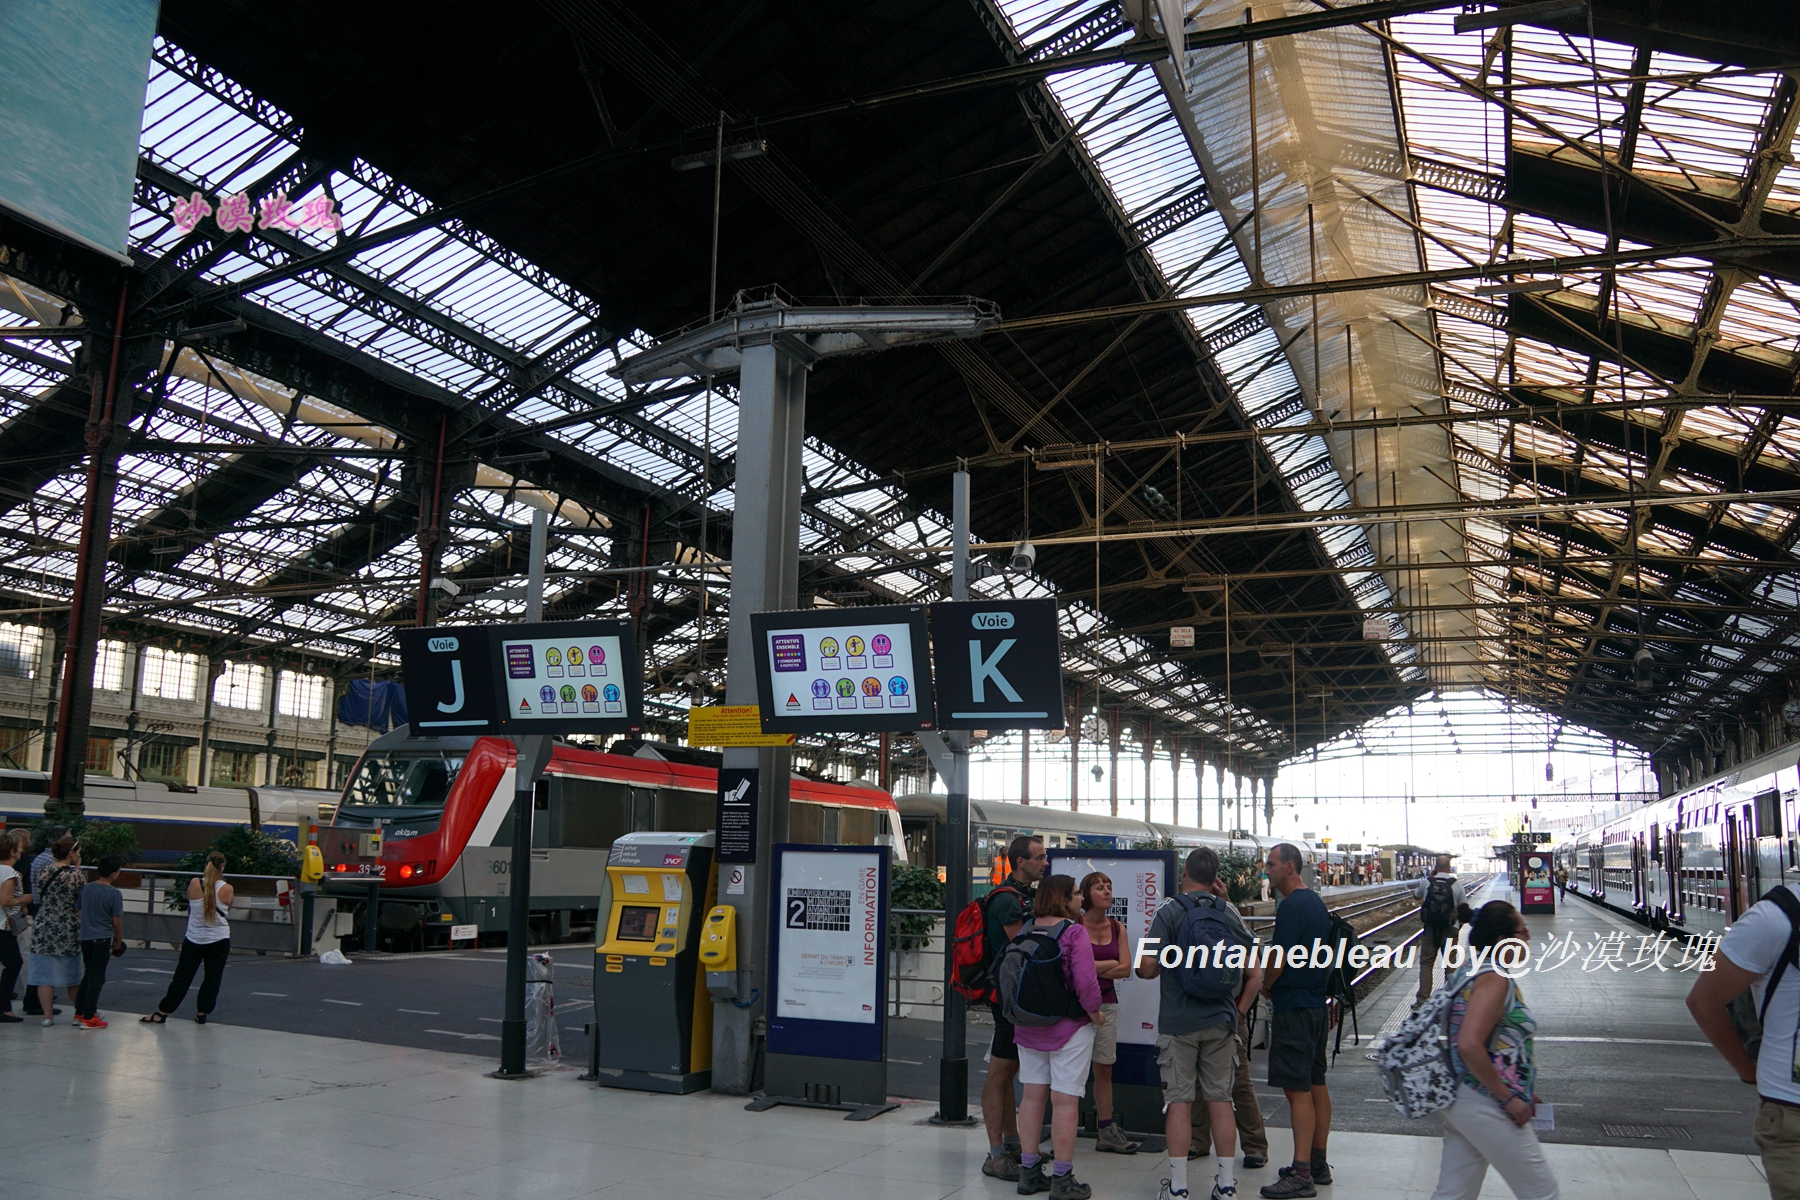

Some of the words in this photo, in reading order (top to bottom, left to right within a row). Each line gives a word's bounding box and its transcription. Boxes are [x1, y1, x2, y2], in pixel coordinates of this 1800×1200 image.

[977, 614, 1008, 627] Voie
[431, 639, 455, 650] Voie
[968, 638, 1025, 703] K
[436, 659, 466, 714] J
[1521, 834, 1529, 843] R
[1535, 834, 1543, 843] R
[858, 867, 866, 891] GARE
[1136, 872, 1144, 898] GARE
[788, 888, 851, 898] EMBARQUEMENT
[858, 892, 865, 905] EN
[808, 897, 845, 906] MINUTES
[1136, 900, 1144, 913] EN
[491, 906, 496, 918] 1
[789, 899, 805, 927] 2
[808, 906, 835, 914] AVANT
[840, 906, 850, 914] LE
[864, 867, 877, 966] INFORMATION
